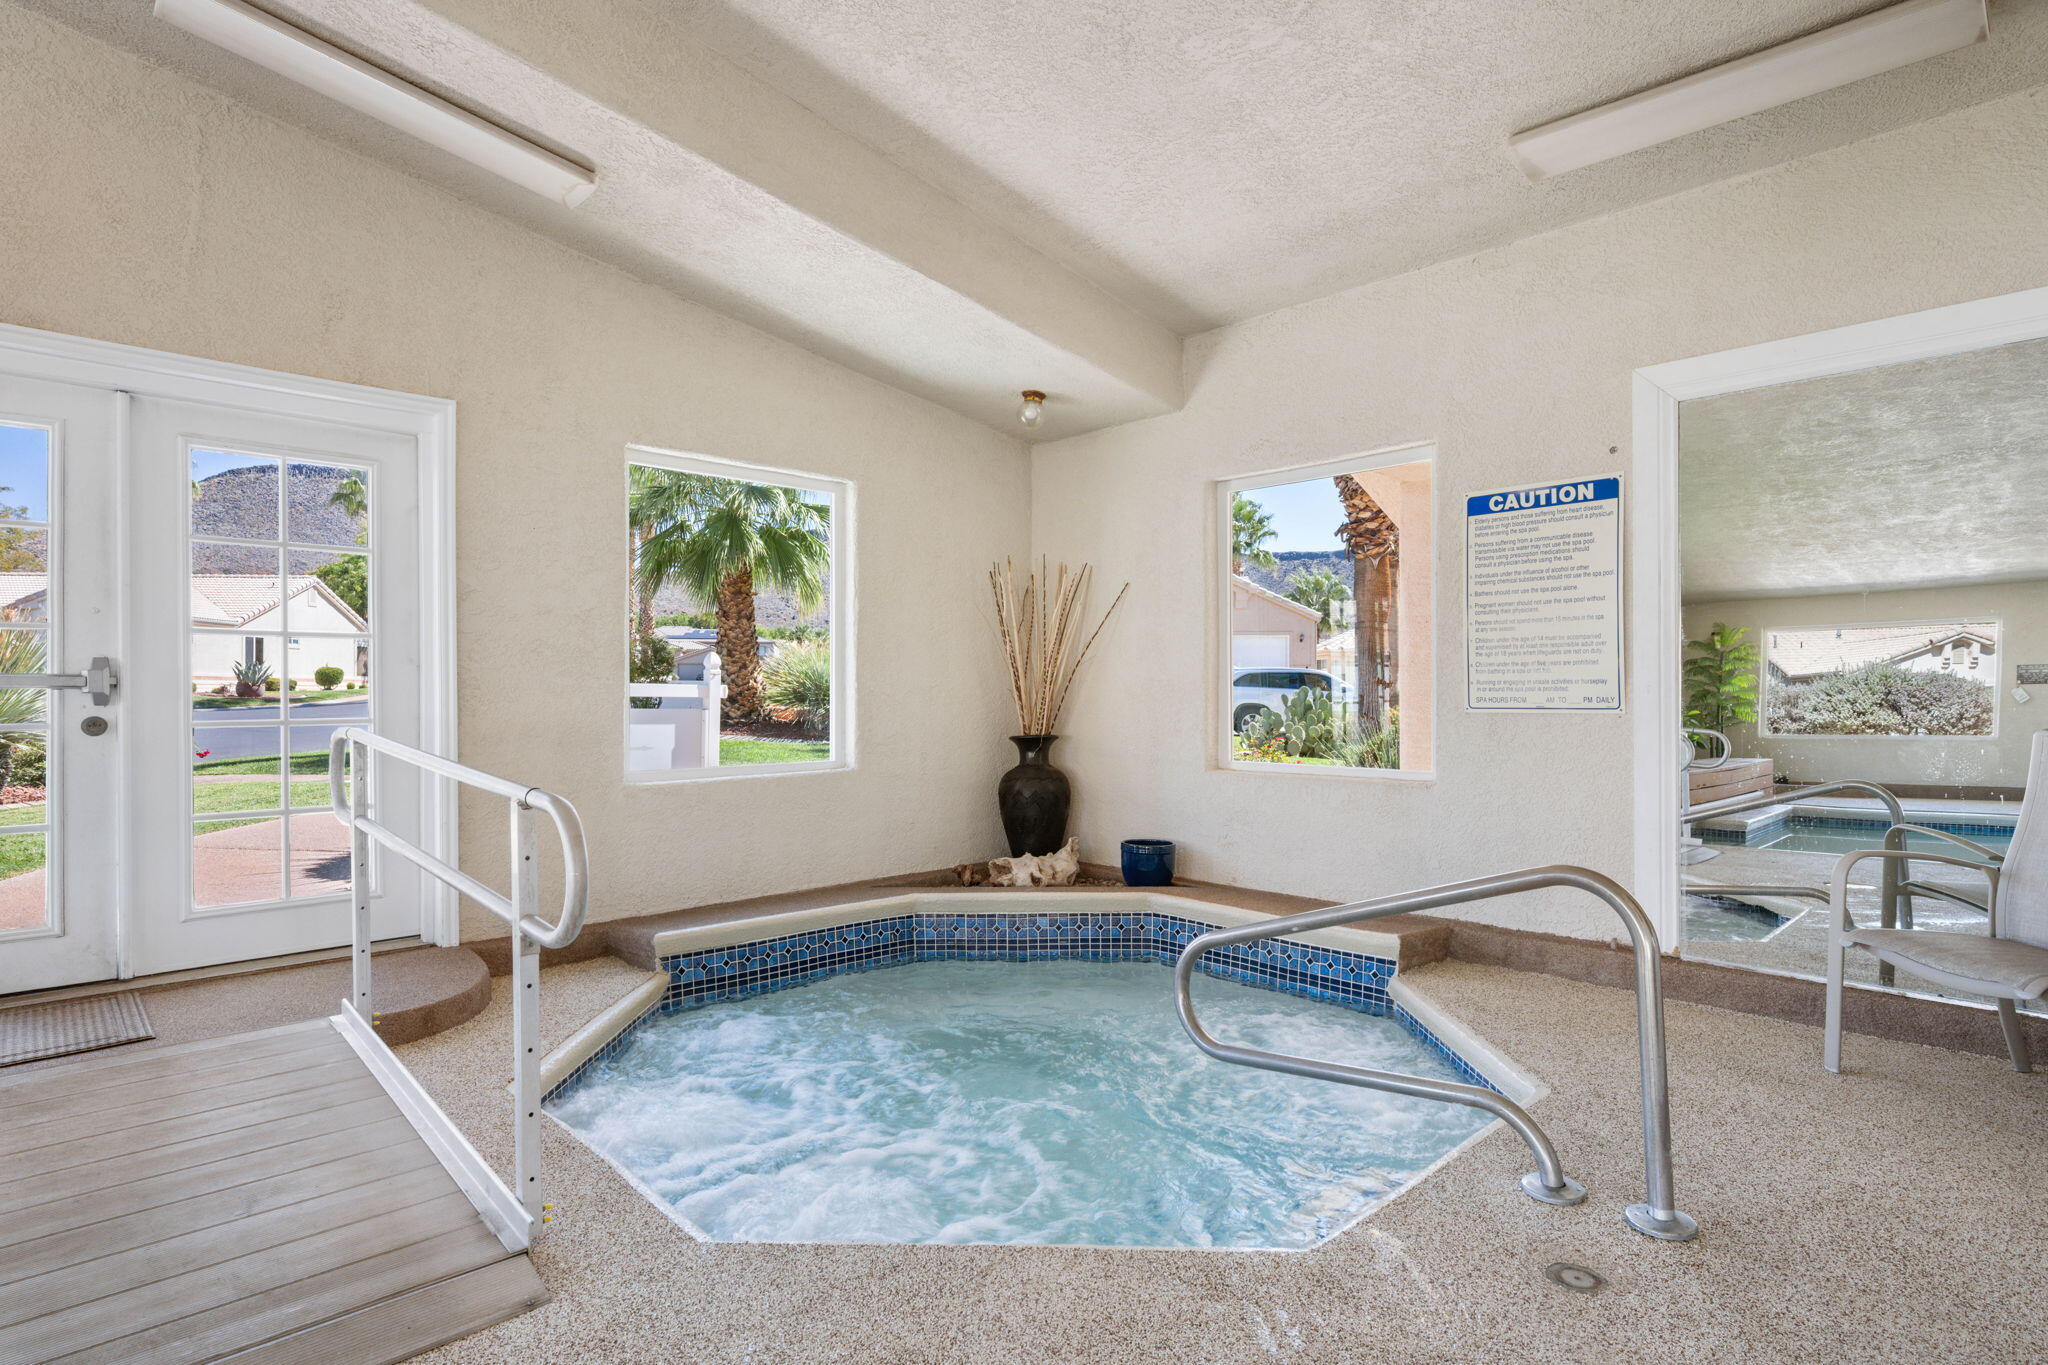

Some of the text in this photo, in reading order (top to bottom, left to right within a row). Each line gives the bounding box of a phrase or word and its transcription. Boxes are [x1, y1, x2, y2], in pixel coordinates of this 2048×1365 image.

[1489, 483, 1594, 511] CAUTION
[1495, 539, 1516, 547] suffering
[1535, 533, 1571, 542] communicable
